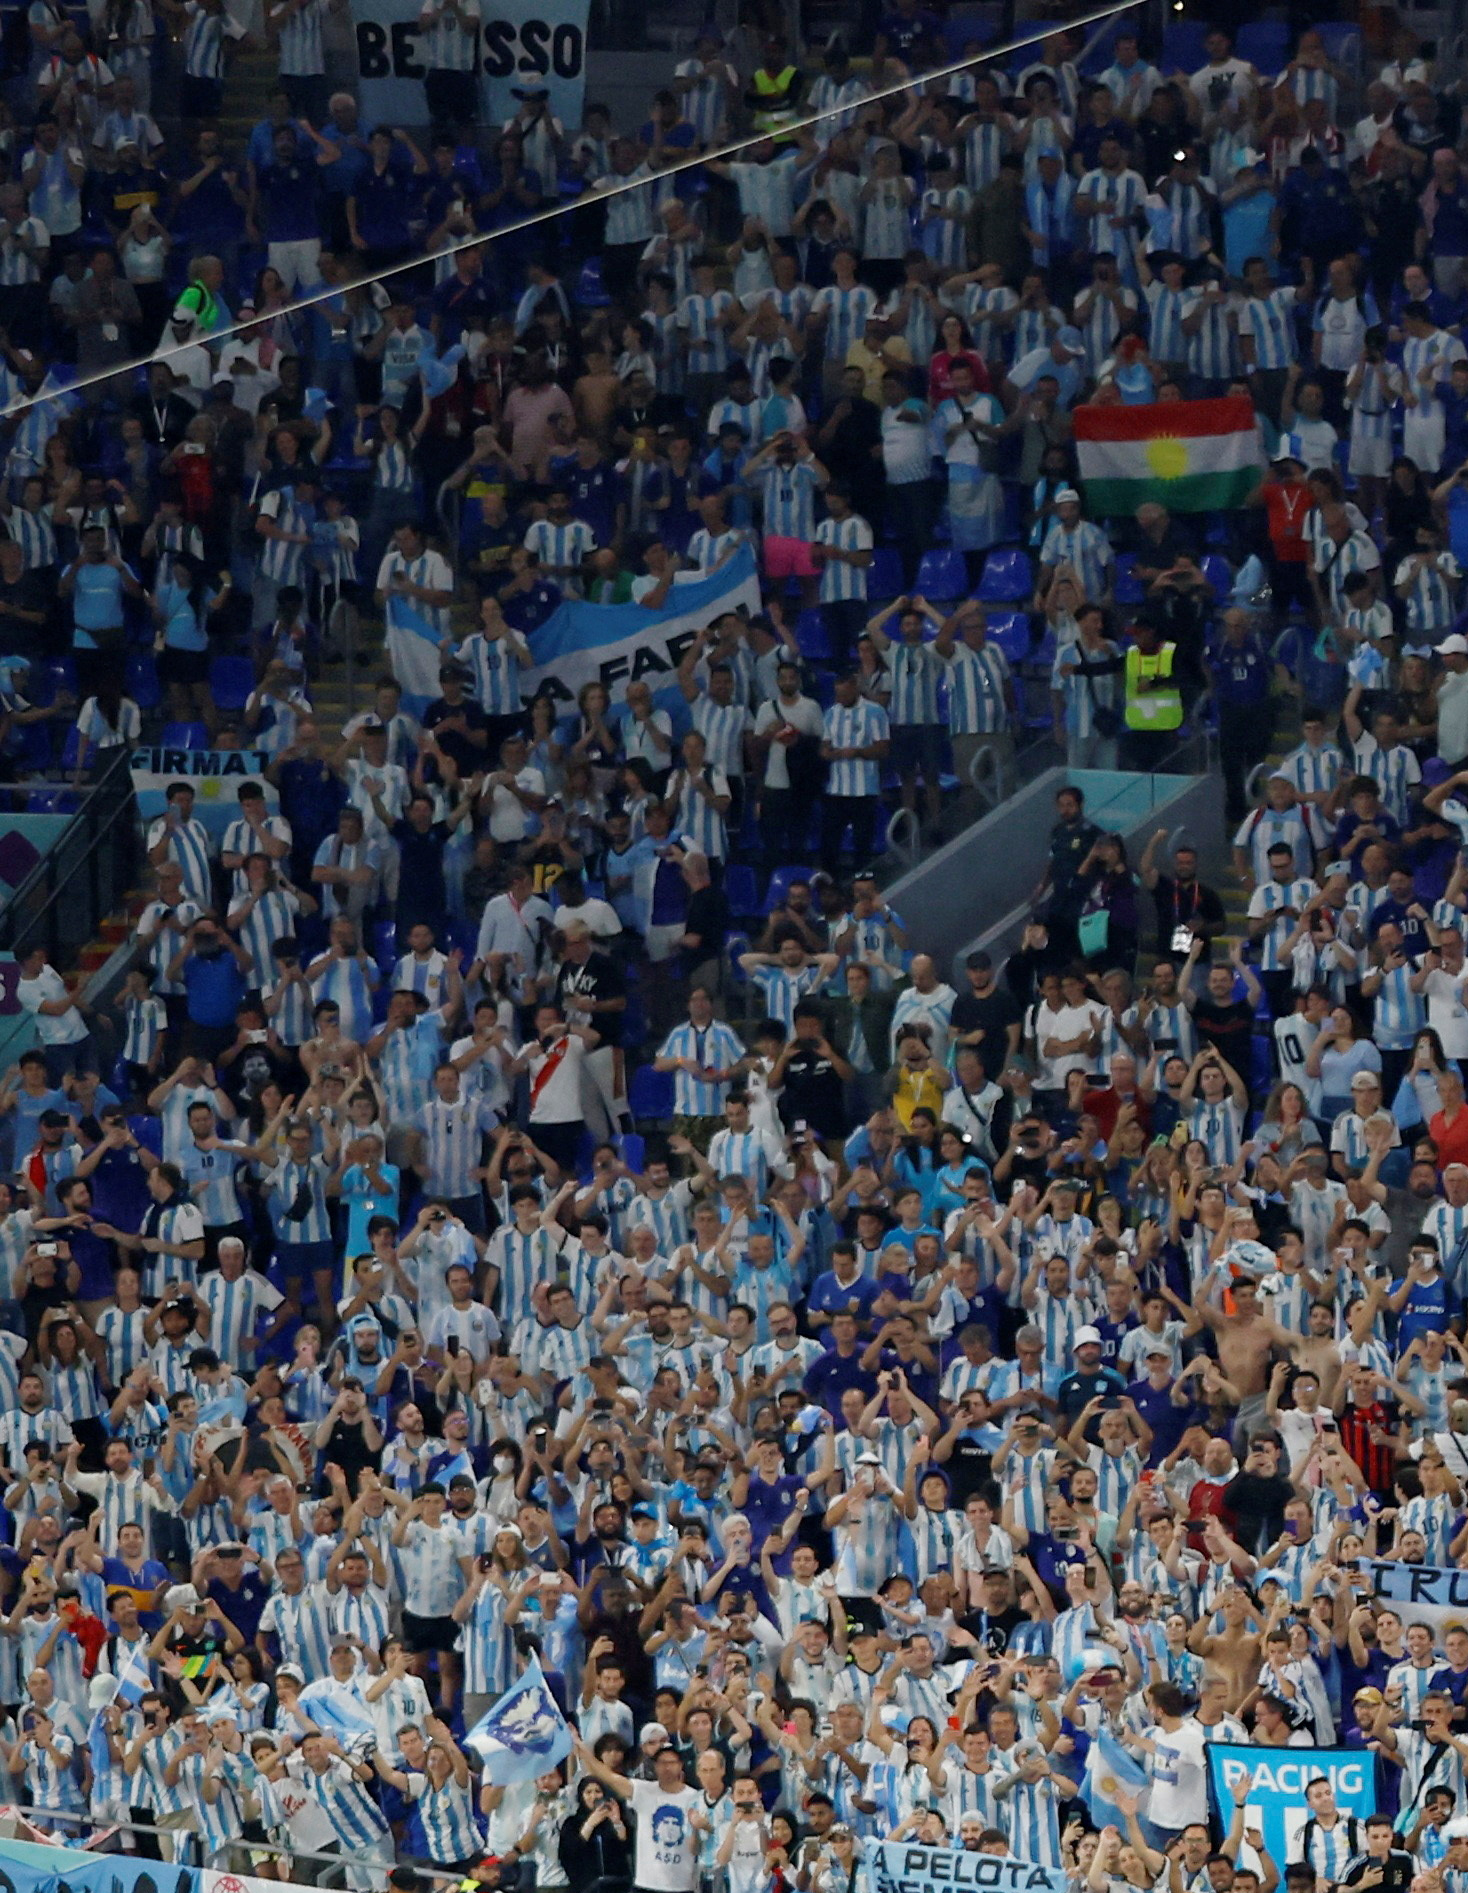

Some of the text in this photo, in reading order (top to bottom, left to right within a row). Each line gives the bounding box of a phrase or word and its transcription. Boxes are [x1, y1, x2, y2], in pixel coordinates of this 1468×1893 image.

[357, 21, 584, 81] BESSO
[1222, 1756, 1364, 1794] RACING
[903, 1850, 1056, 1891] PELOTA
